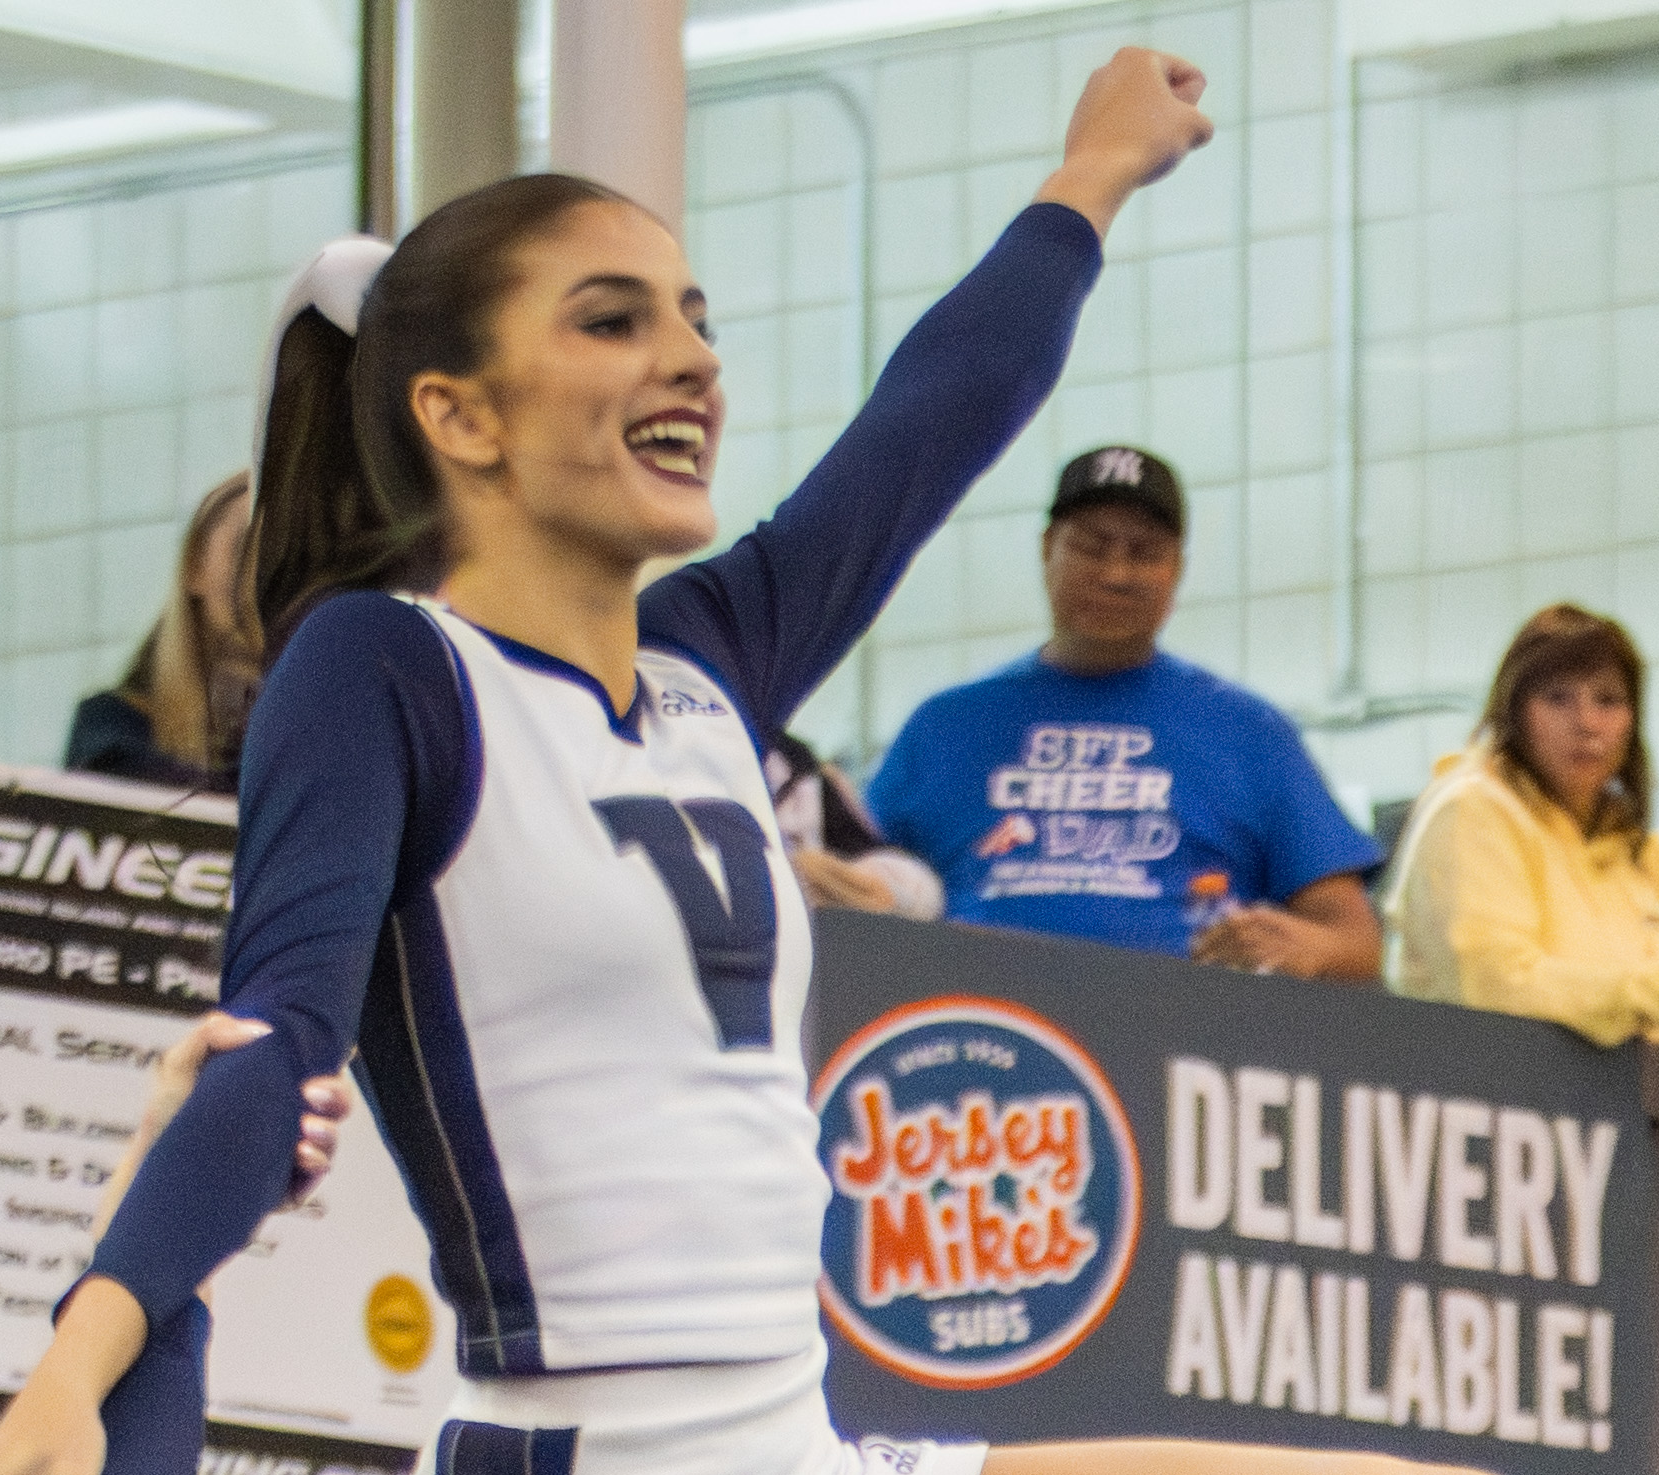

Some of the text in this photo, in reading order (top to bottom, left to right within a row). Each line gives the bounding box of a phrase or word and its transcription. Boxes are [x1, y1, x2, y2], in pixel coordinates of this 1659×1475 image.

[988, 769, 1173, 811] CHEER
[1045, 814, 1182, 864] DAD
[589, 793, 777, 1052] V
[831, 1075, 1093, 1205] Jersey
[1165, 1056, 1621, 1288] DELIVERY
[856, 1183, 1099, 1309] Mike's
[929, 1296, 1032, 1353] SUBS
[1166, 1251, 1616, 1455] AVAILABLE!
